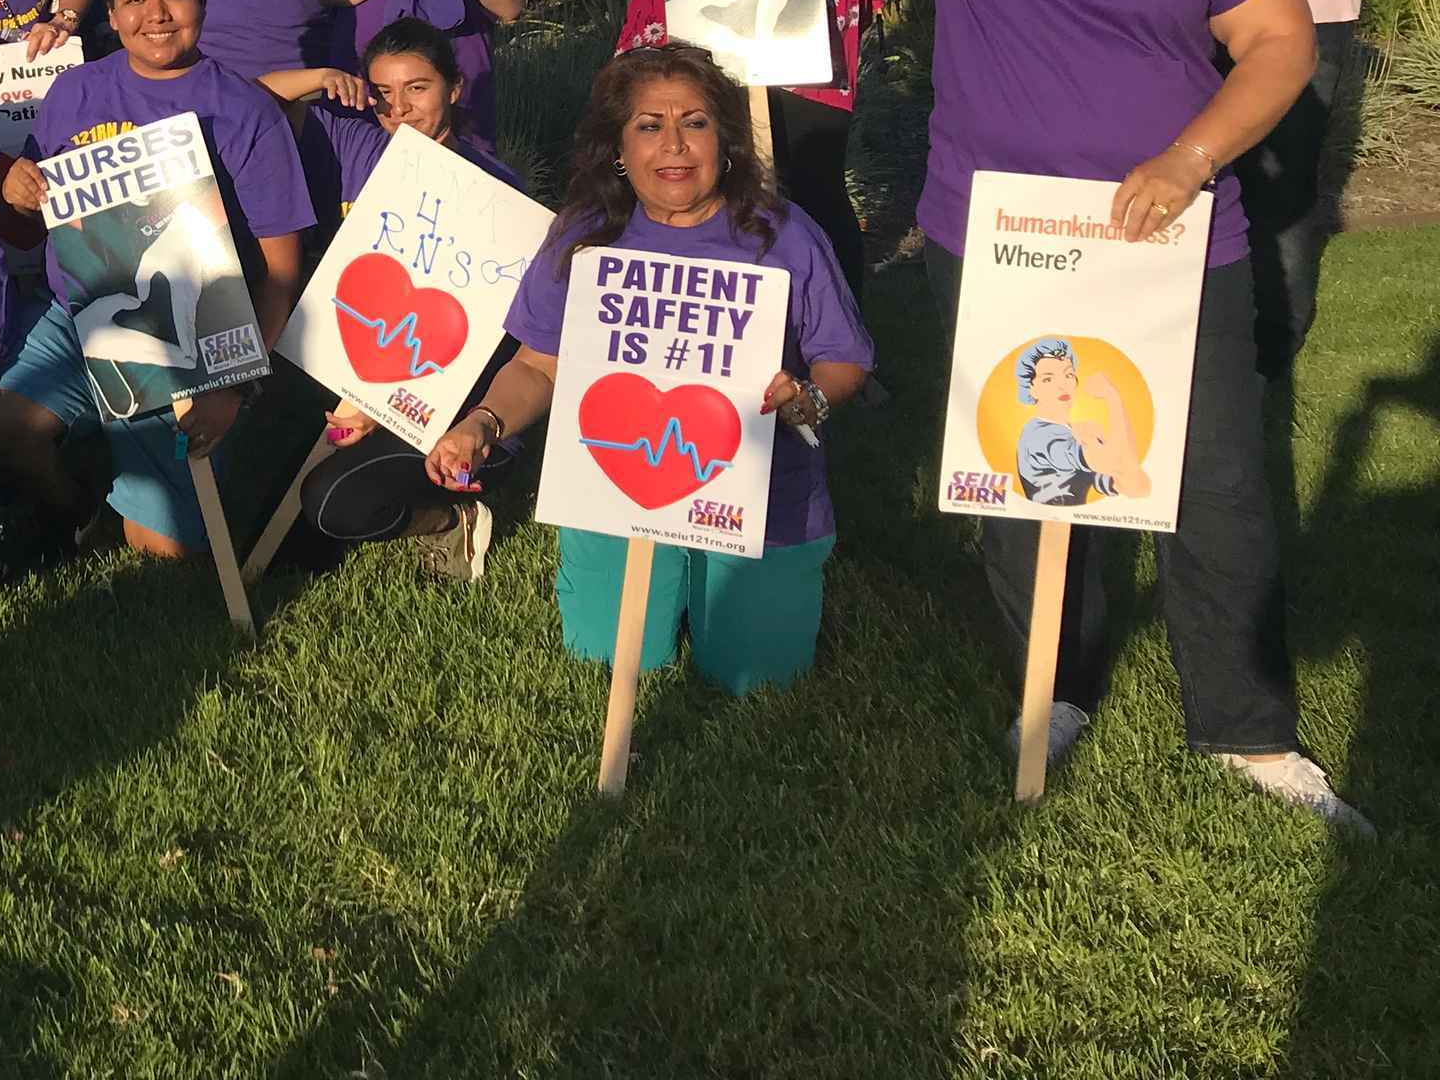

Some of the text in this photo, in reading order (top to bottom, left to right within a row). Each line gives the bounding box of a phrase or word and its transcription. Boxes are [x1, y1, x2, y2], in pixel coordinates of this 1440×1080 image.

[11, 61, 76, 81] Nurses
[70, 122, 117, 145] 121RN
[42, 123, 193, 190] NURSES
[417, 191, 441, 239] 4
[994, 243, 1082, 272] Where?
[597, 256, 763, 305] PATIENT
[598, 293, 754, 340] SAFETY
[608, 330, 733, 377] IS #1!
[171, 366, 269, 400] www.seiu121rn.org
[951, 470, 1009, 489] SEIU
[692, 499, 744, 517] SEIU
[947, 484, 1007, 505] 121RN
[688, 510, 744, 532] 121RN
[1073, 512, 1172, 529] www.seiu121rn.org
[631, 525, 746, 553] www.seiu121rn.org
